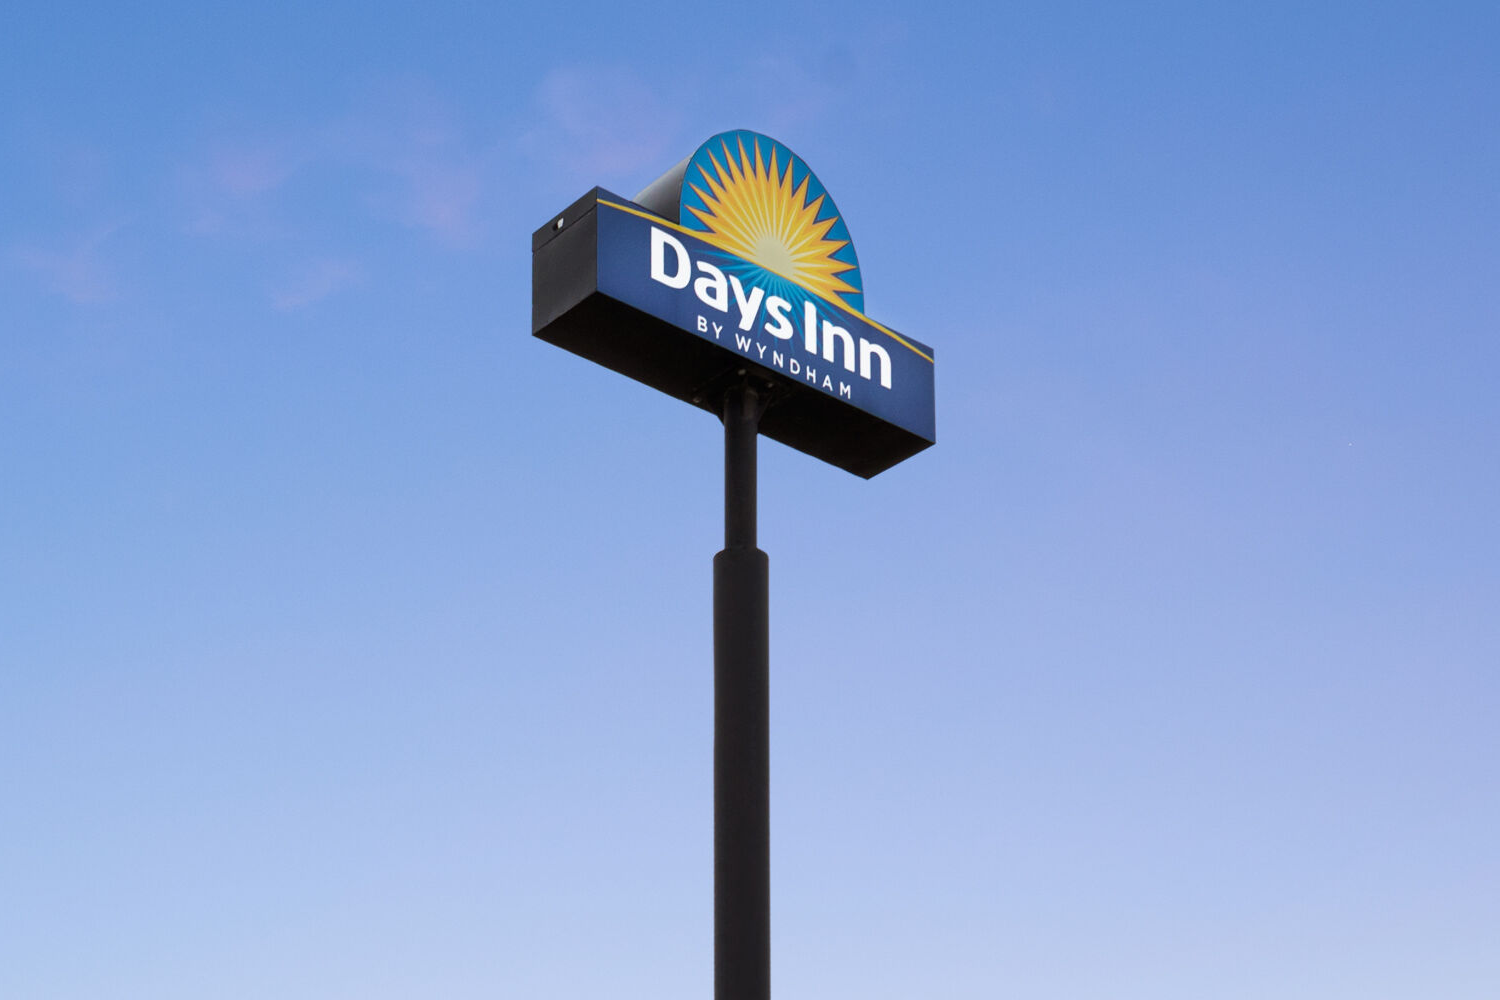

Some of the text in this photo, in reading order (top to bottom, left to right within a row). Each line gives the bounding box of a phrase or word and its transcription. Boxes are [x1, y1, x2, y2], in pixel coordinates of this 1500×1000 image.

[650, 226, 892, 390] Days Inn
[697, 315, 852, 400] BY WYNDHAM
